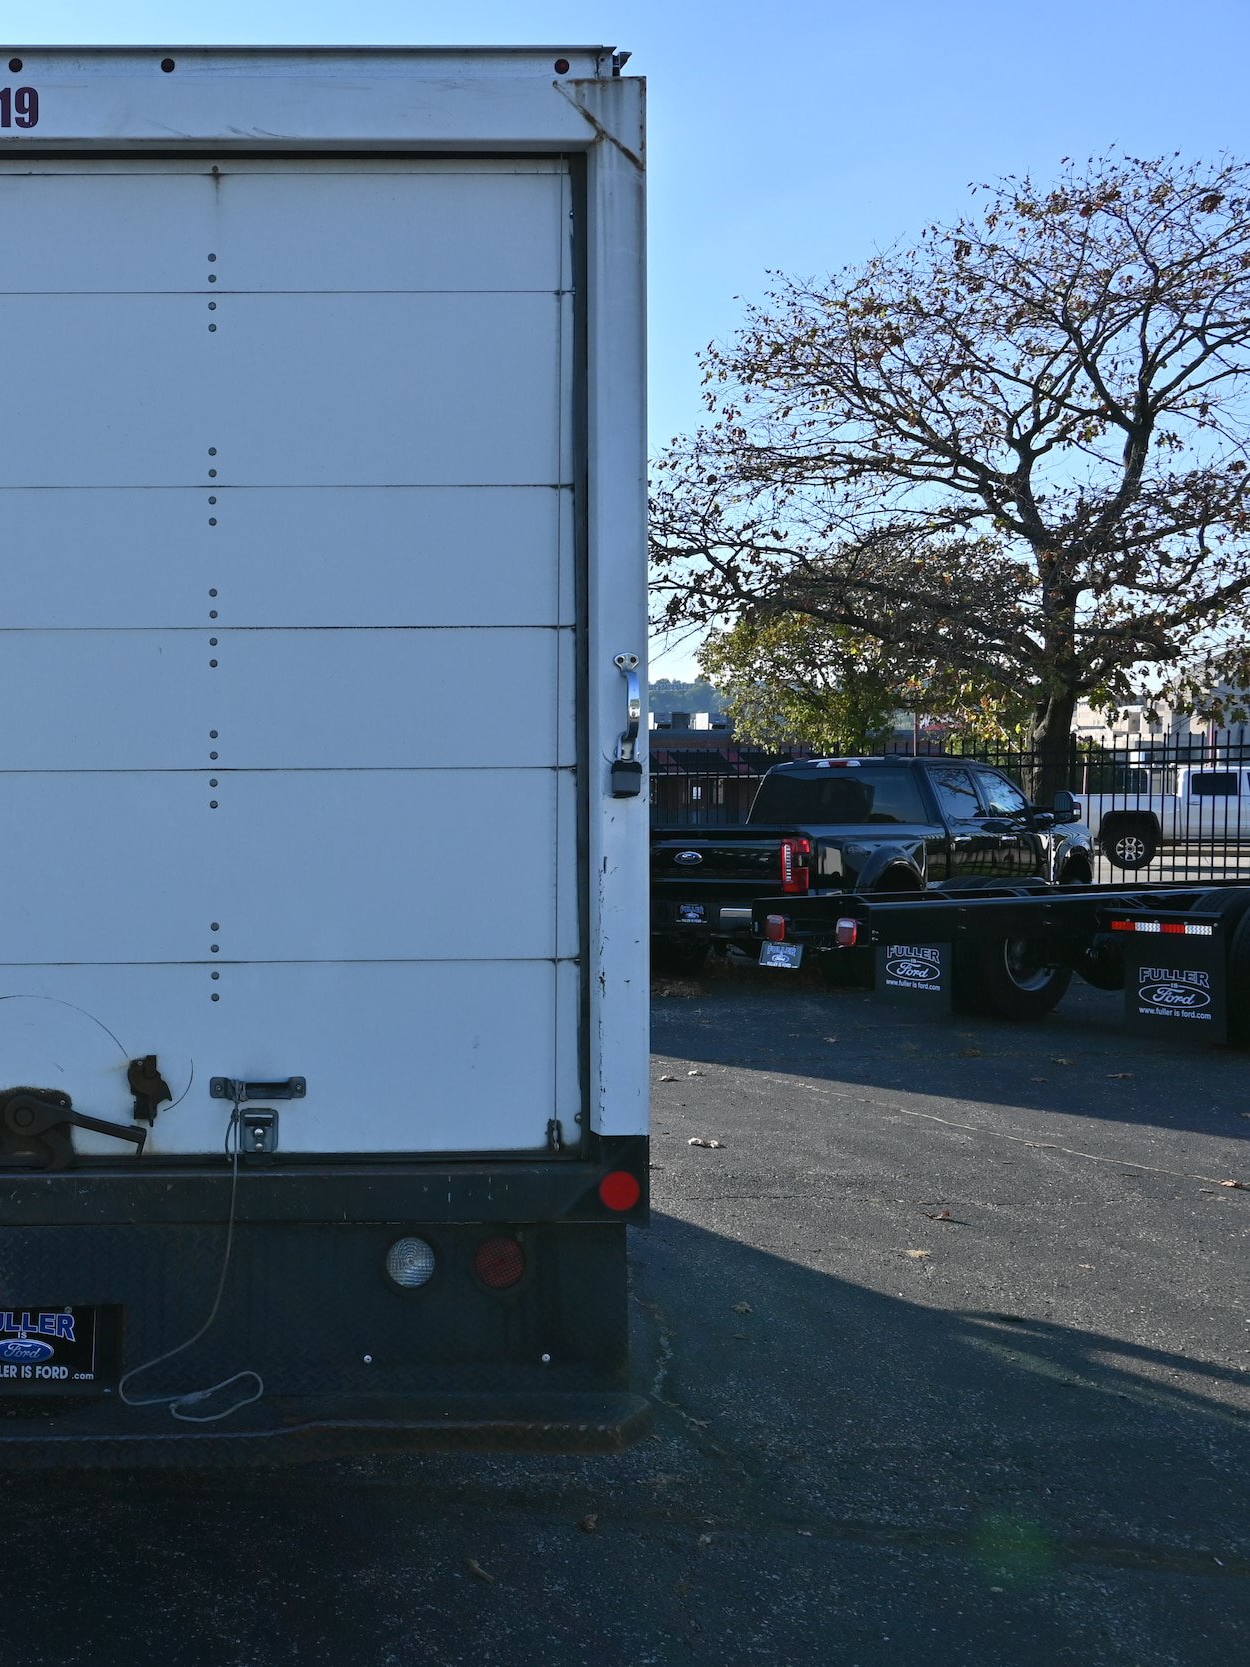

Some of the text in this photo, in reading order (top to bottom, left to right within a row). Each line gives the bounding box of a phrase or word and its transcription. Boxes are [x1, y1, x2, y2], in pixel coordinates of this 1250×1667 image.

[886, 945, 941, 964] FULLER
[896, 962, 929, 978] Ford
[1139, 967, 1210, 989] FULLER
[1152, 987, 1196, 1005] Ford
[1181, 1009, 1211, 1020] ford.com
[17, 1331, 27, 1339] IS
[3, 1342, 42, 1359] Ford
[21, 1365, 32, 1379] IS
[35, 1366, 69, 1380] FORD
[71, 1371, 94, 1380] .com
